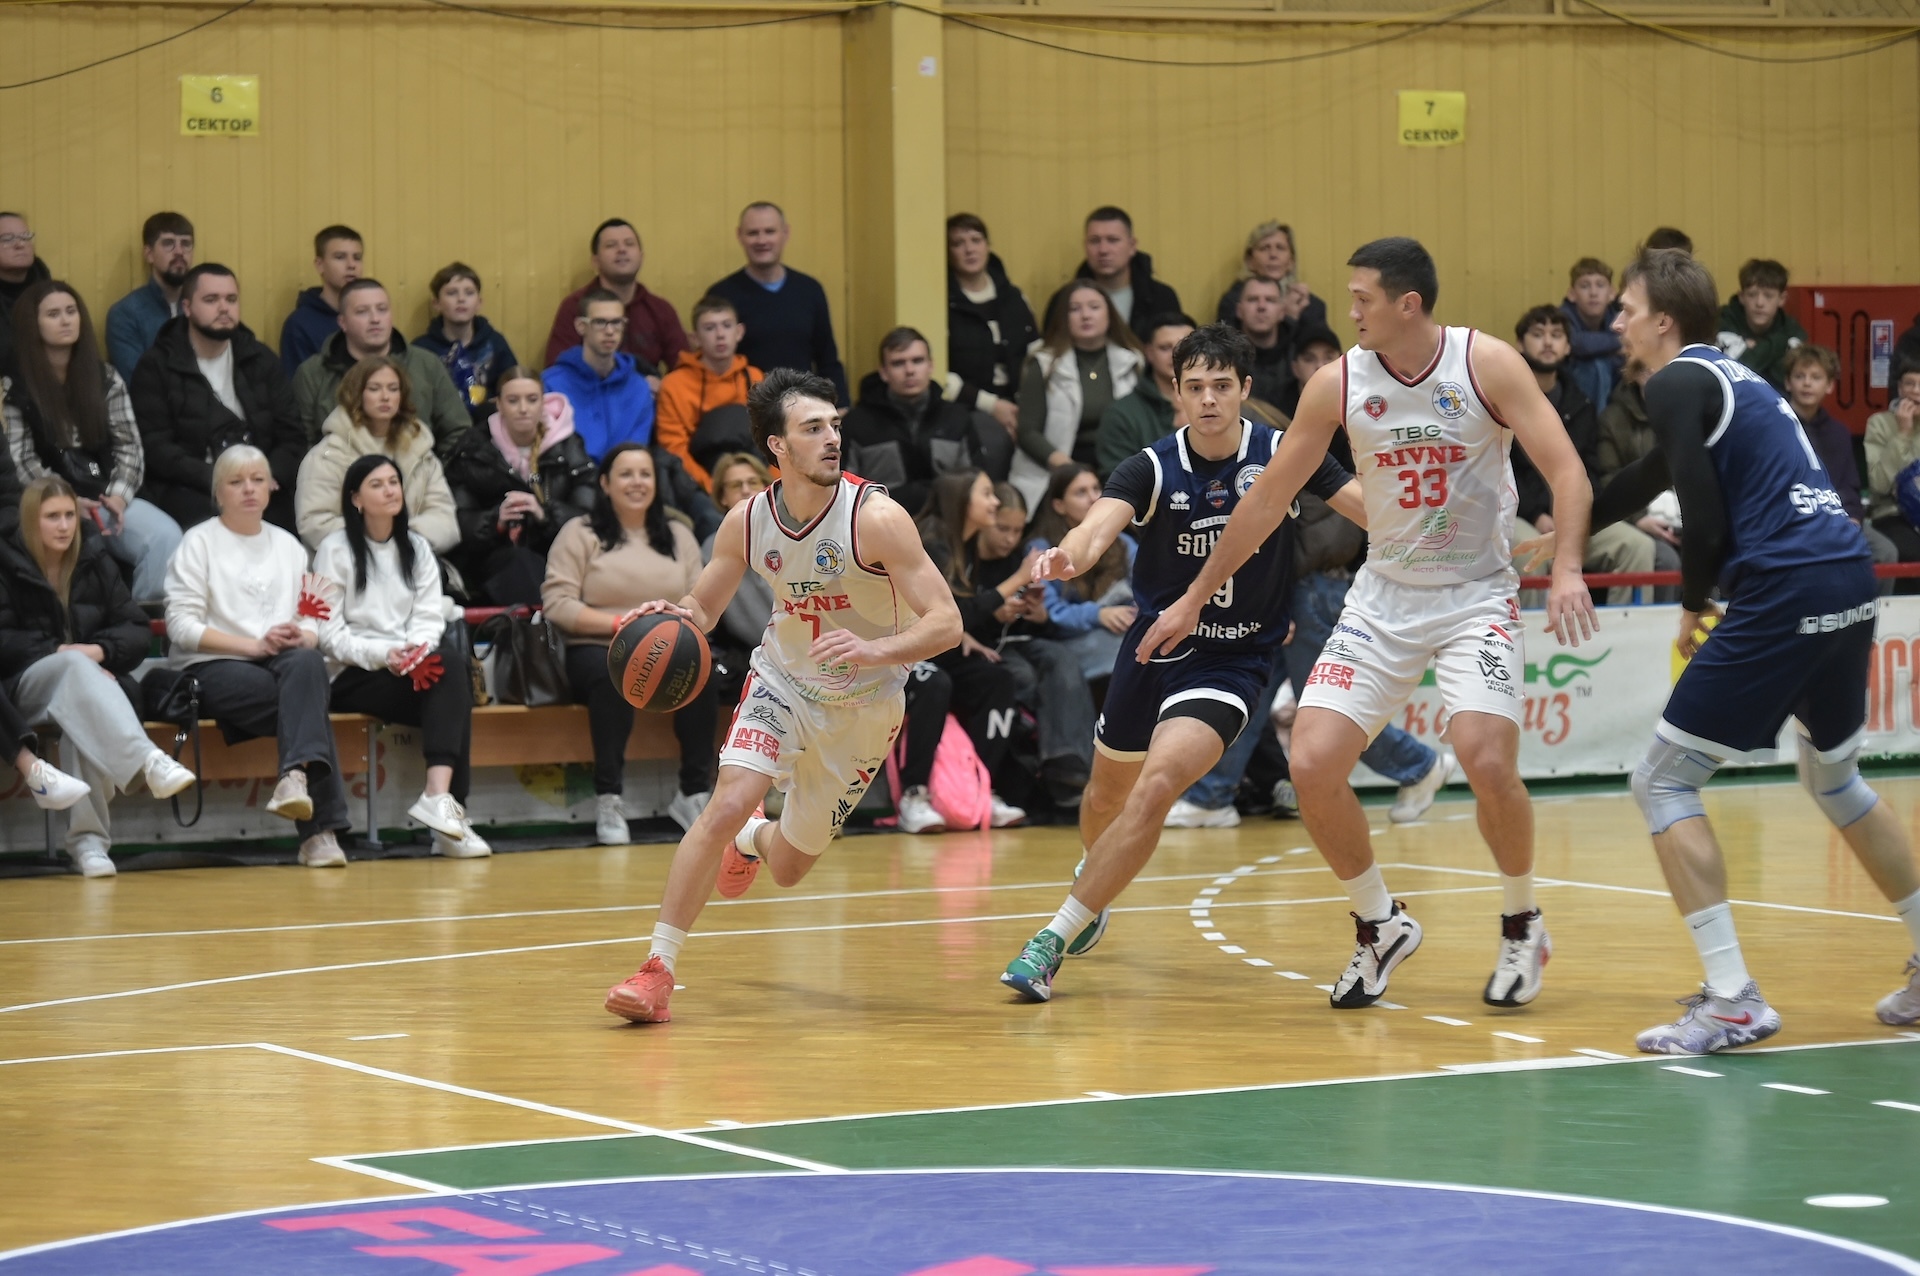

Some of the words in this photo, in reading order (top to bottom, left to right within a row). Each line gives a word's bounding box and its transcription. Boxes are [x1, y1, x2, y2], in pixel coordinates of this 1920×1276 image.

[211, 86, 223, 103] 6
[1424, 100, 1435, 115] 7
[187, 118, 252, 131] СЕКТОР
[1403, 129, 1459, 141] СЕКТОР
[1390, 424, 1442, 440] TBG
[1374, 445, 1467, 468] RIVNE
[1398, 467, 1449, 509] 33
[799, 613, 820, 642] 7
[629, 635, 671, 700] SPALDING
[1311, 662, 1355, 680] NTER
[1306, 674, 1352, 691] ETON
[1484, 679, 1515, 691] VECTOR
[1487, 685, 1517, 699] GLOBAL
[1576, 686, 1593, 697] TM
[987, 707, 1015, 739] N
[391, 733, 412, 745] TM
[736, 727, 780, 752] INTER
[732, 738, 780, 763] BETON
